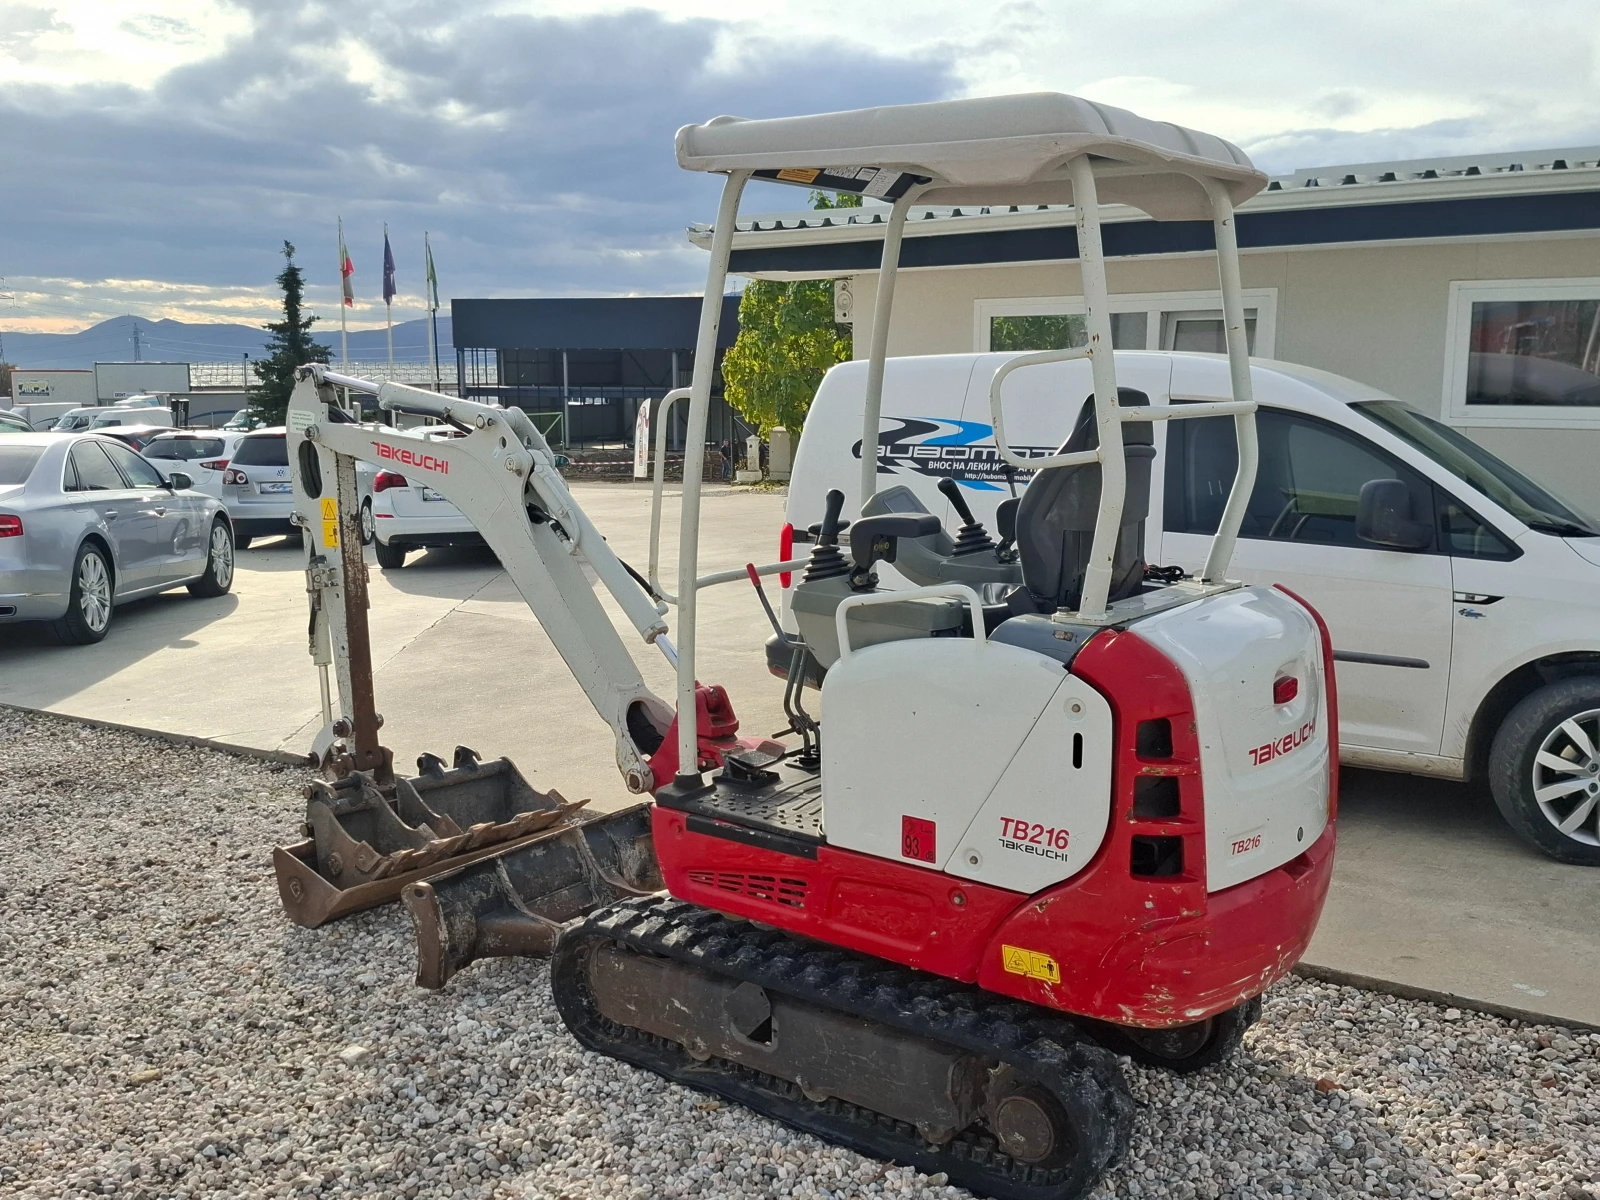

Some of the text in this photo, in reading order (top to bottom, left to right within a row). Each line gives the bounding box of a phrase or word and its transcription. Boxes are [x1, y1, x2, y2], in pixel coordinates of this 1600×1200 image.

[370, 441, 449, 475] TAKEUCHI
[928, 461, 952, 470] ВНОС
[952, 462, 965, 470] НА
[966, 462, 990, 472] ЛЕКИ
[1248, 717, 1316, 767] TAKEUCHI
[1000, 816, 1070, 850] TB216
[1231, 834, 1262, 856] TB216
[905, 835, 920, 858] 93
[998, 838, 1068, 862] TAKEUCHI
